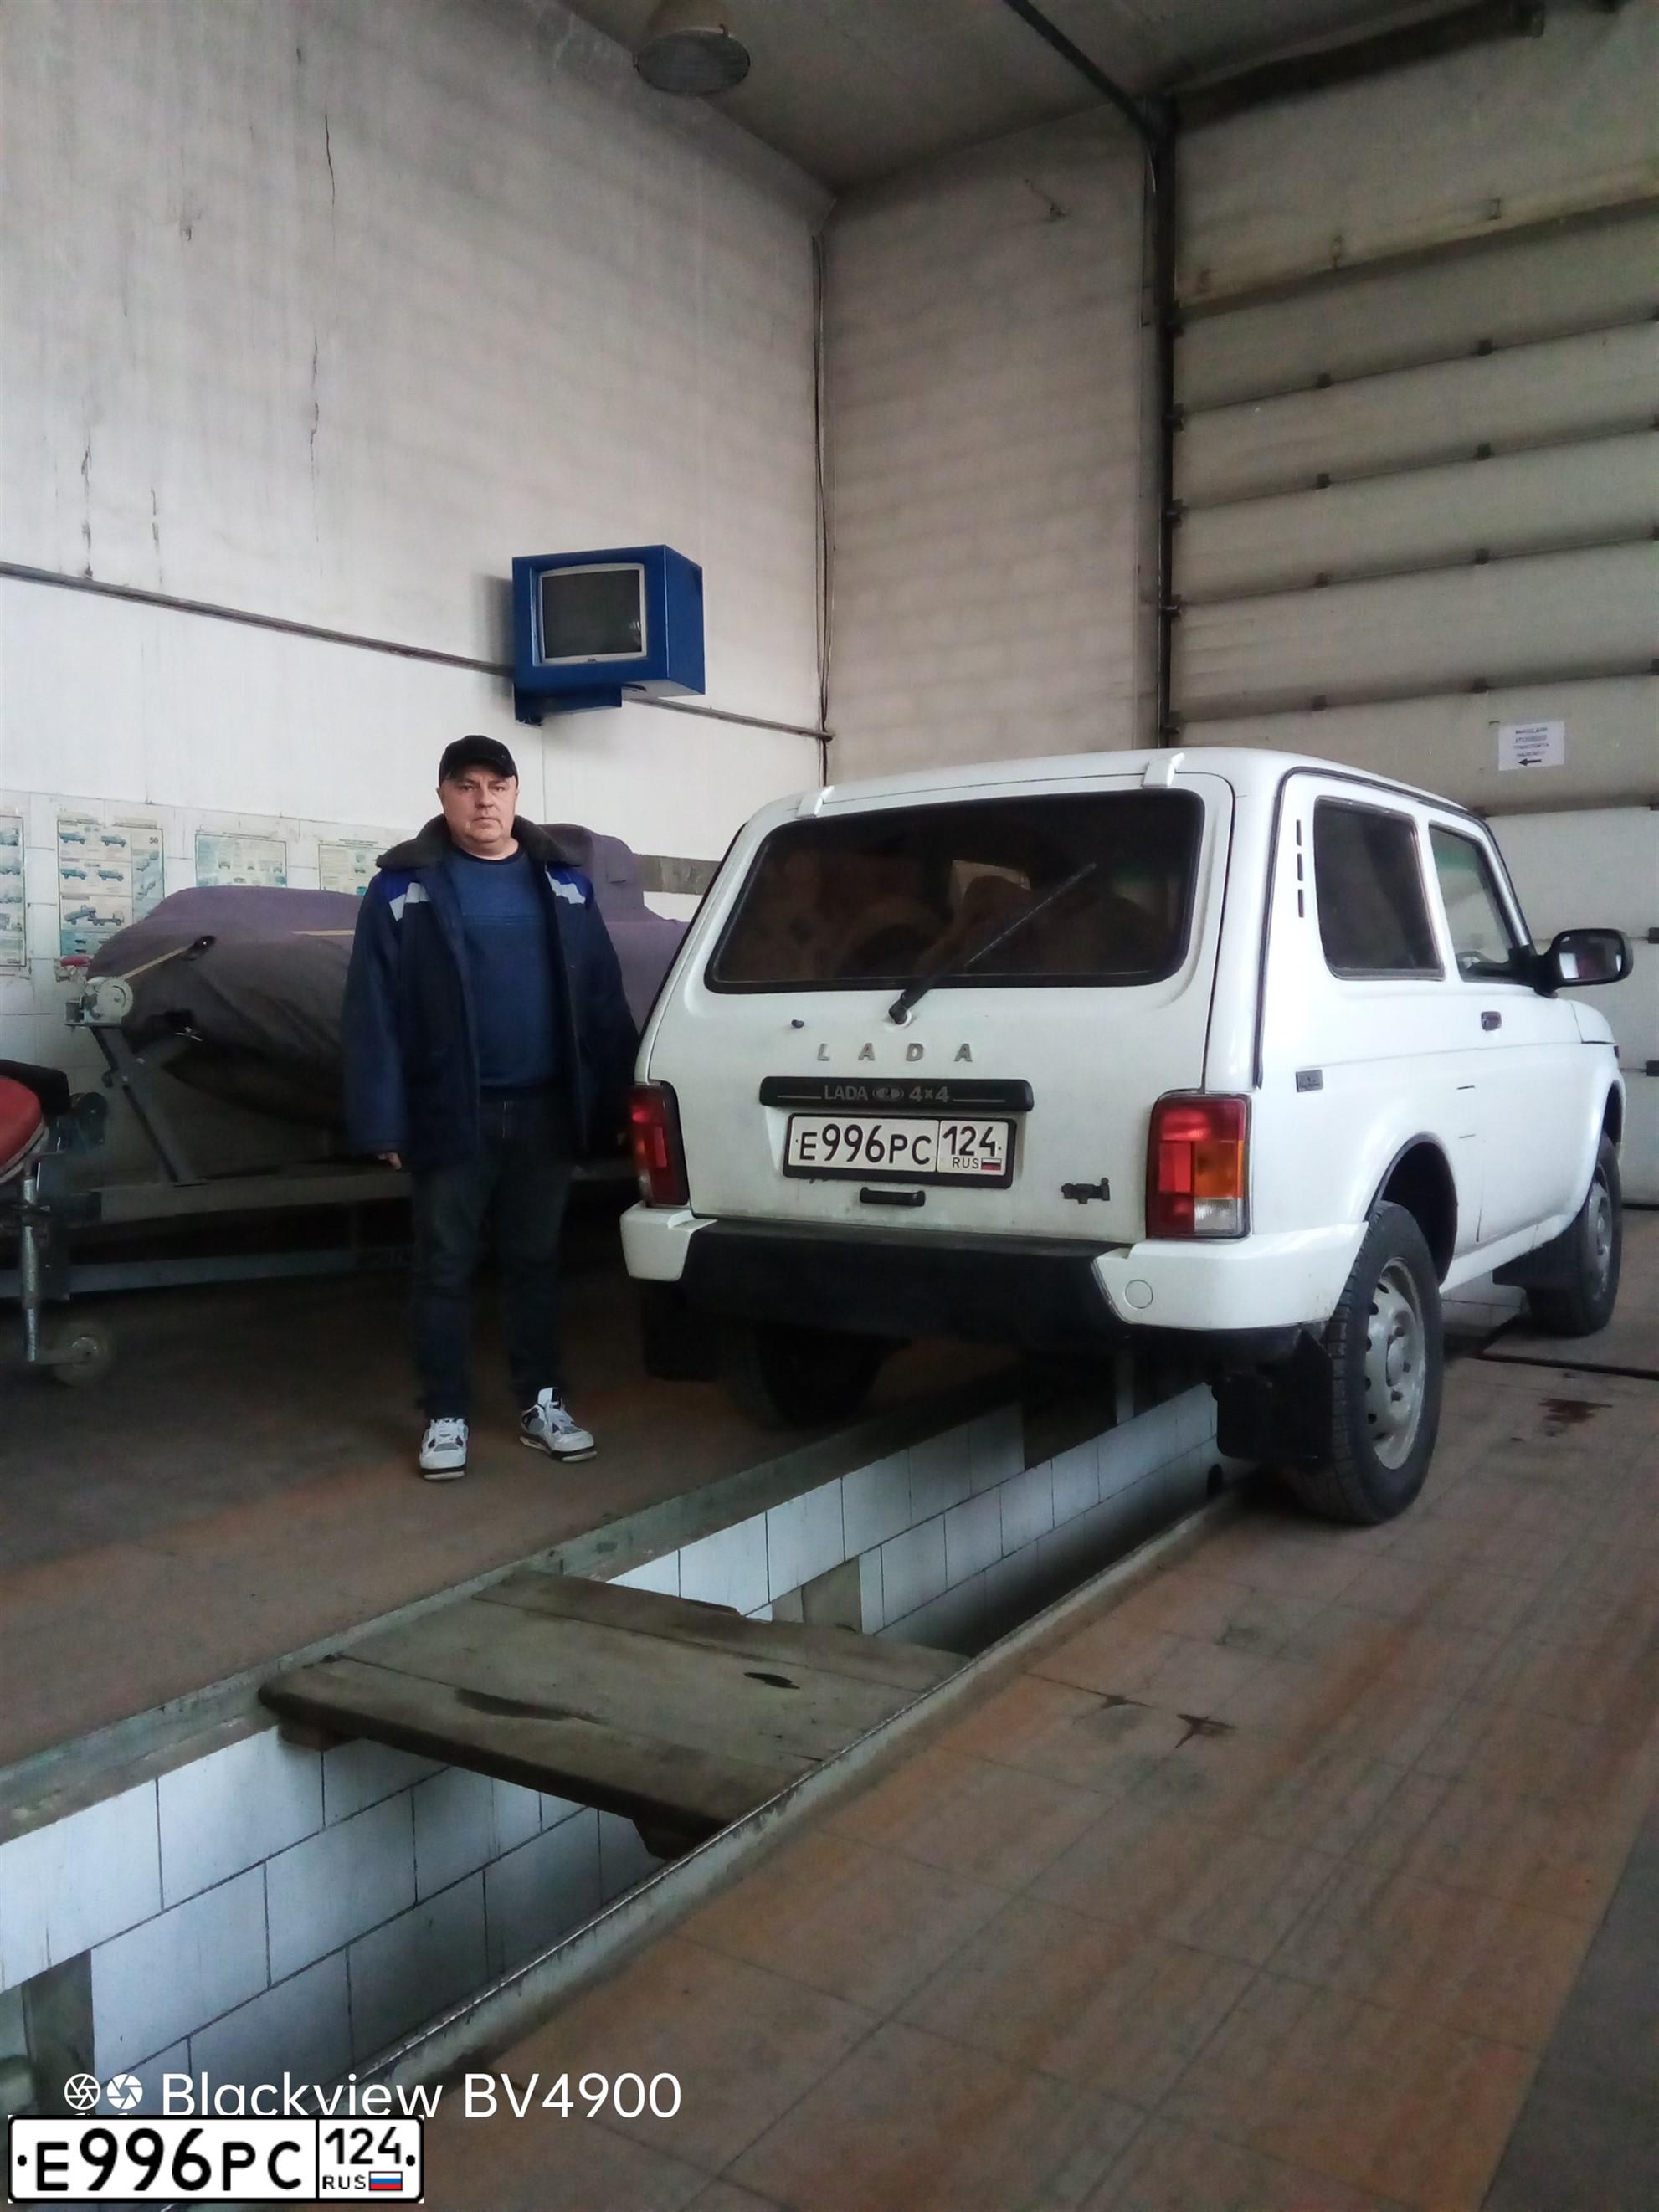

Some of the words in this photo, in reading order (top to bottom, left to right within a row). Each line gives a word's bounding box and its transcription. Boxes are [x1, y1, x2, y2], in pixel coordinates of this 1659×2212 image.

[817, 1043, 973, 1063] LADA
[824, 1085, 868, 1101] LADA
[909, 1086, 949, 1103] 4x4
[799, 1123, 932, 1166] E996PC
[942, 1125, 996, 1157] 124
[952, 1157, 980, 1169] RUS
